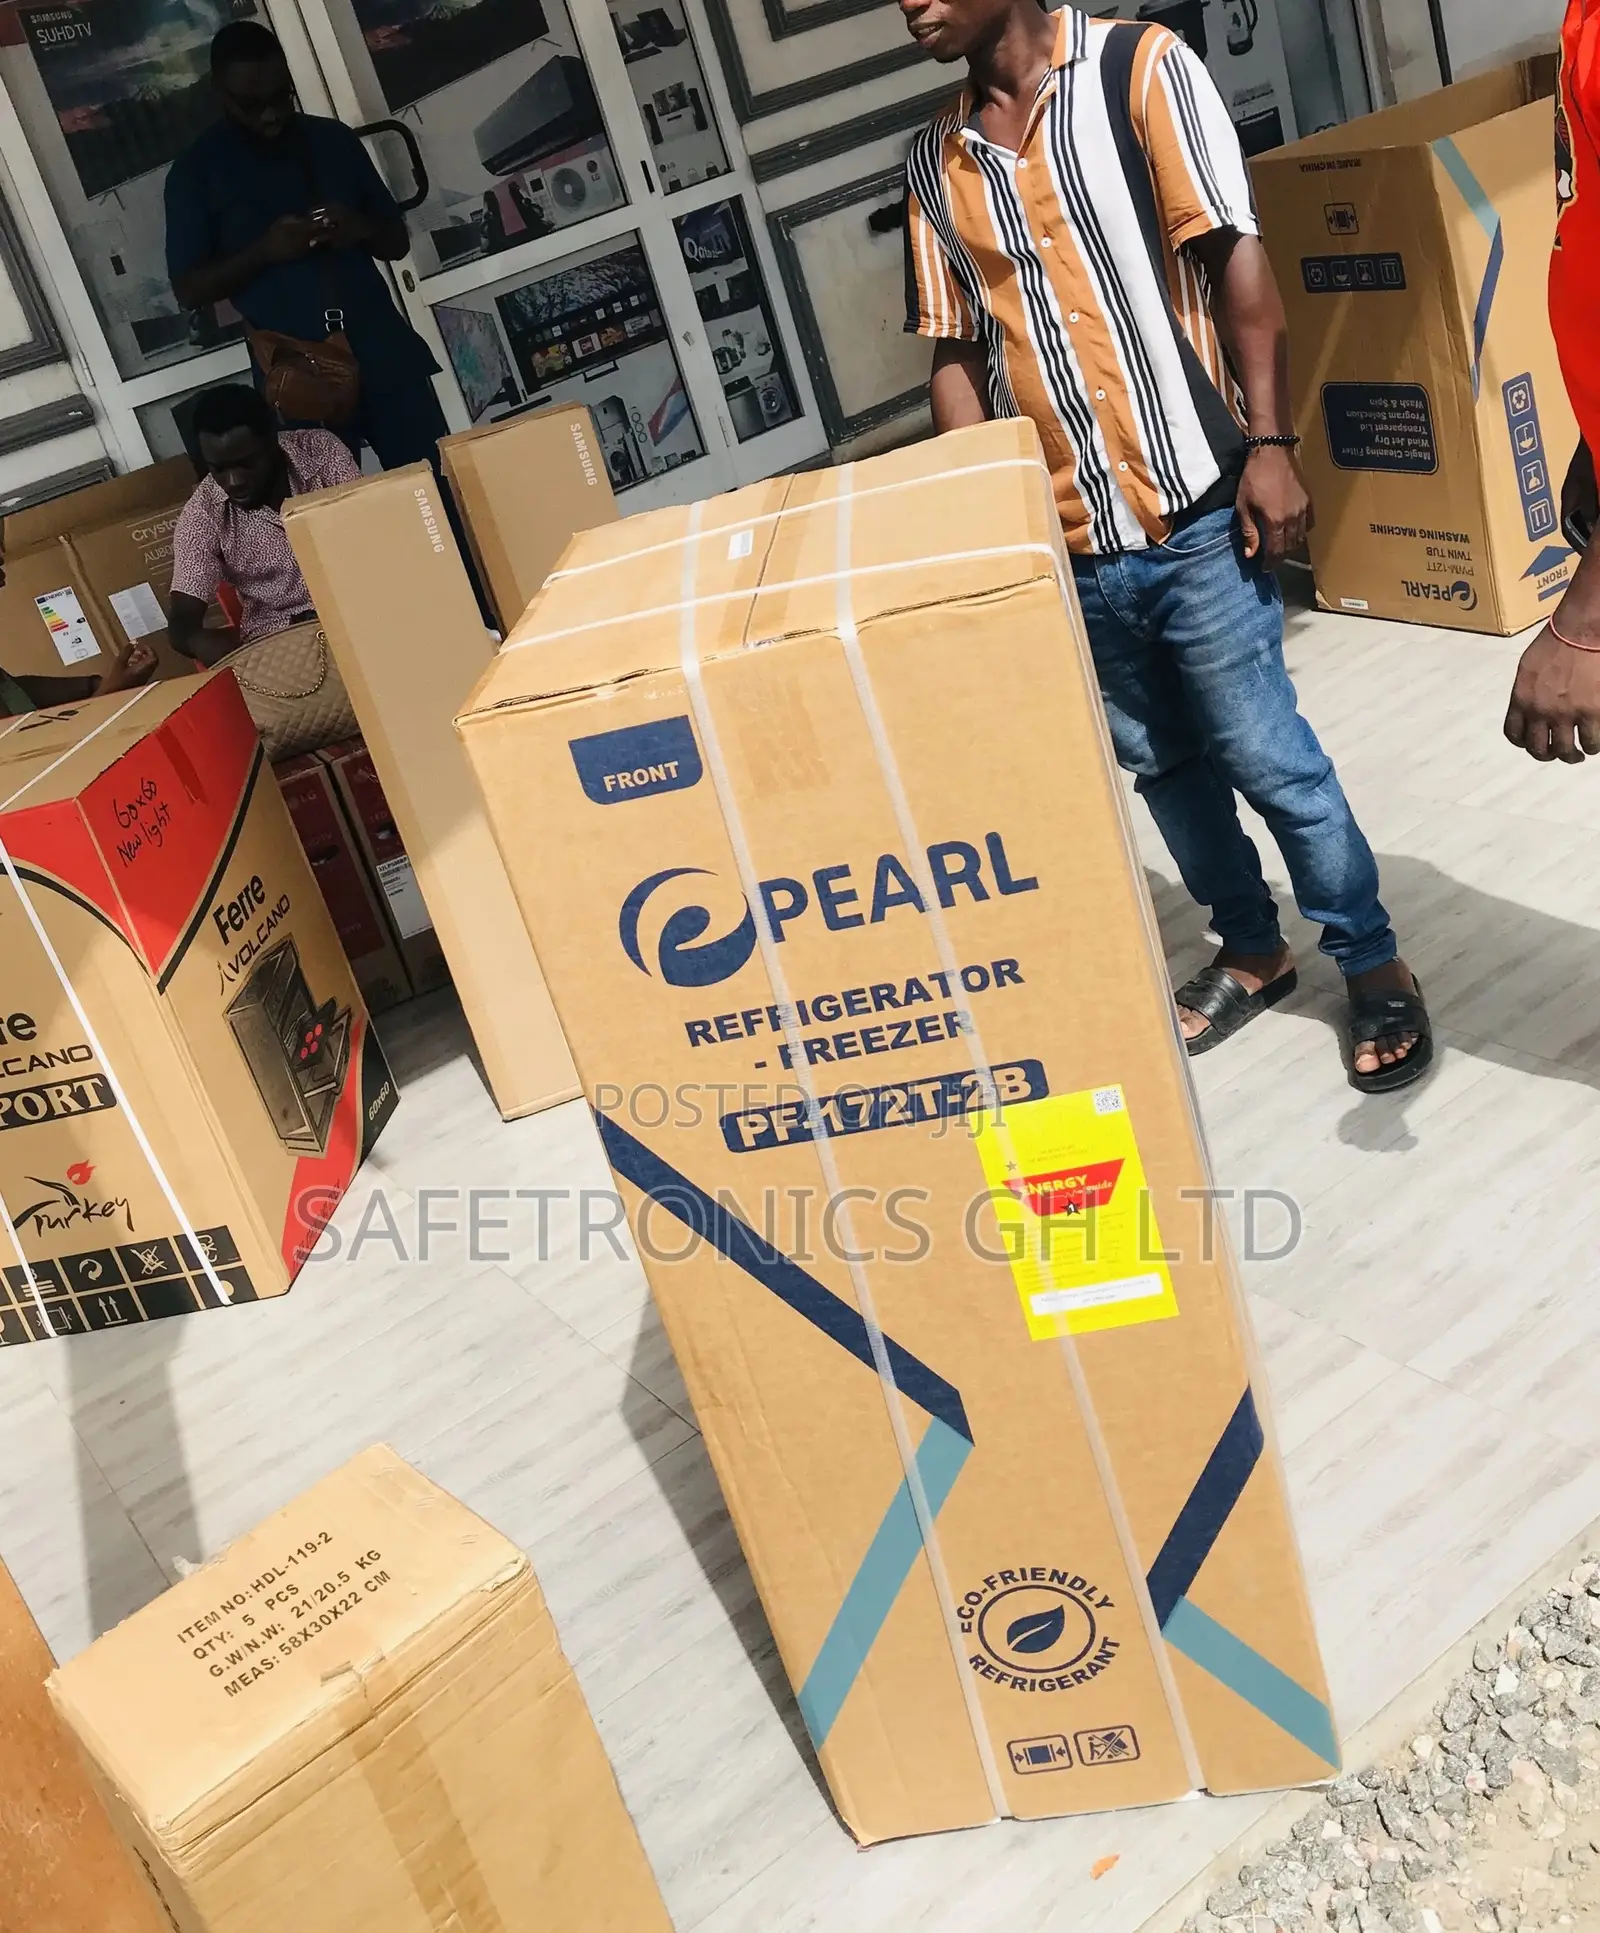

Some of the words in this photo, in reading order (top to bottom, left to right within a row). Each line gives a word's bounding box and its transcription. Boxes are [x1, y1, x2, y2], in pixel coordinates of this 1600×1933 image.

[1388, 412, 1426, 422] Program
[1400, 399, 1425, 409] Wash
[1374, 423, 1428, 435] Transparent
[1374, 434, 1390, 445] Dry
[1408, 437, 1430, 447] Wind
[570, 422, 598, 486] SAMSUNG
[1365, 446, 1402, 458] Cleaning
[1404, 448, 1431, 460] Magic
[413, 488, 445, 553] SAMSUNG
[1369, 523, 1417, 538] MACHINE
[1419, 529, 1470, 544] WASHING
[1426, 546, 1446, 558] TUB
[1447, 549, 1472, 561] TWIN
[1401, 580, 1452, 601] PEARL
[1536, 566, 1568, 590] FRONT
[603, 760, 679, 792] FRONT
[757, 831, 1040, 944] PEARL
[212, 875, 266, 946] Ferre
[228, 894, 291, 975] VOLCANO
[684, 957, 1026, 1048] REFRIGERATOR
[777, 1010, 976, 1071] FREEZER
[736, 1066, 1032, 1147] PF-172T-2B
[1019, 1174, 1088, 1197] ENERGY
[290, 1570, 351, 1619] 21/20.5
[354, 1549, 382, 1571] KG
[956, 1567, 1115, 1634] ECO-FRIENDLY
[177, 1610, 222, 1644] ITEM
[192, 1629, 235, 1660] QTY:
[241, 1614, 256, 1627] 5
[264, 1583, 300, 1612] PCS
[223, 1656, 280, 1698] MEAS:
[278, 1591, 363, 1657] 58X30X22
[364, 1570, 391, 1593] CM
[968, 1636, 1121, 1693] REFRIGERANT
